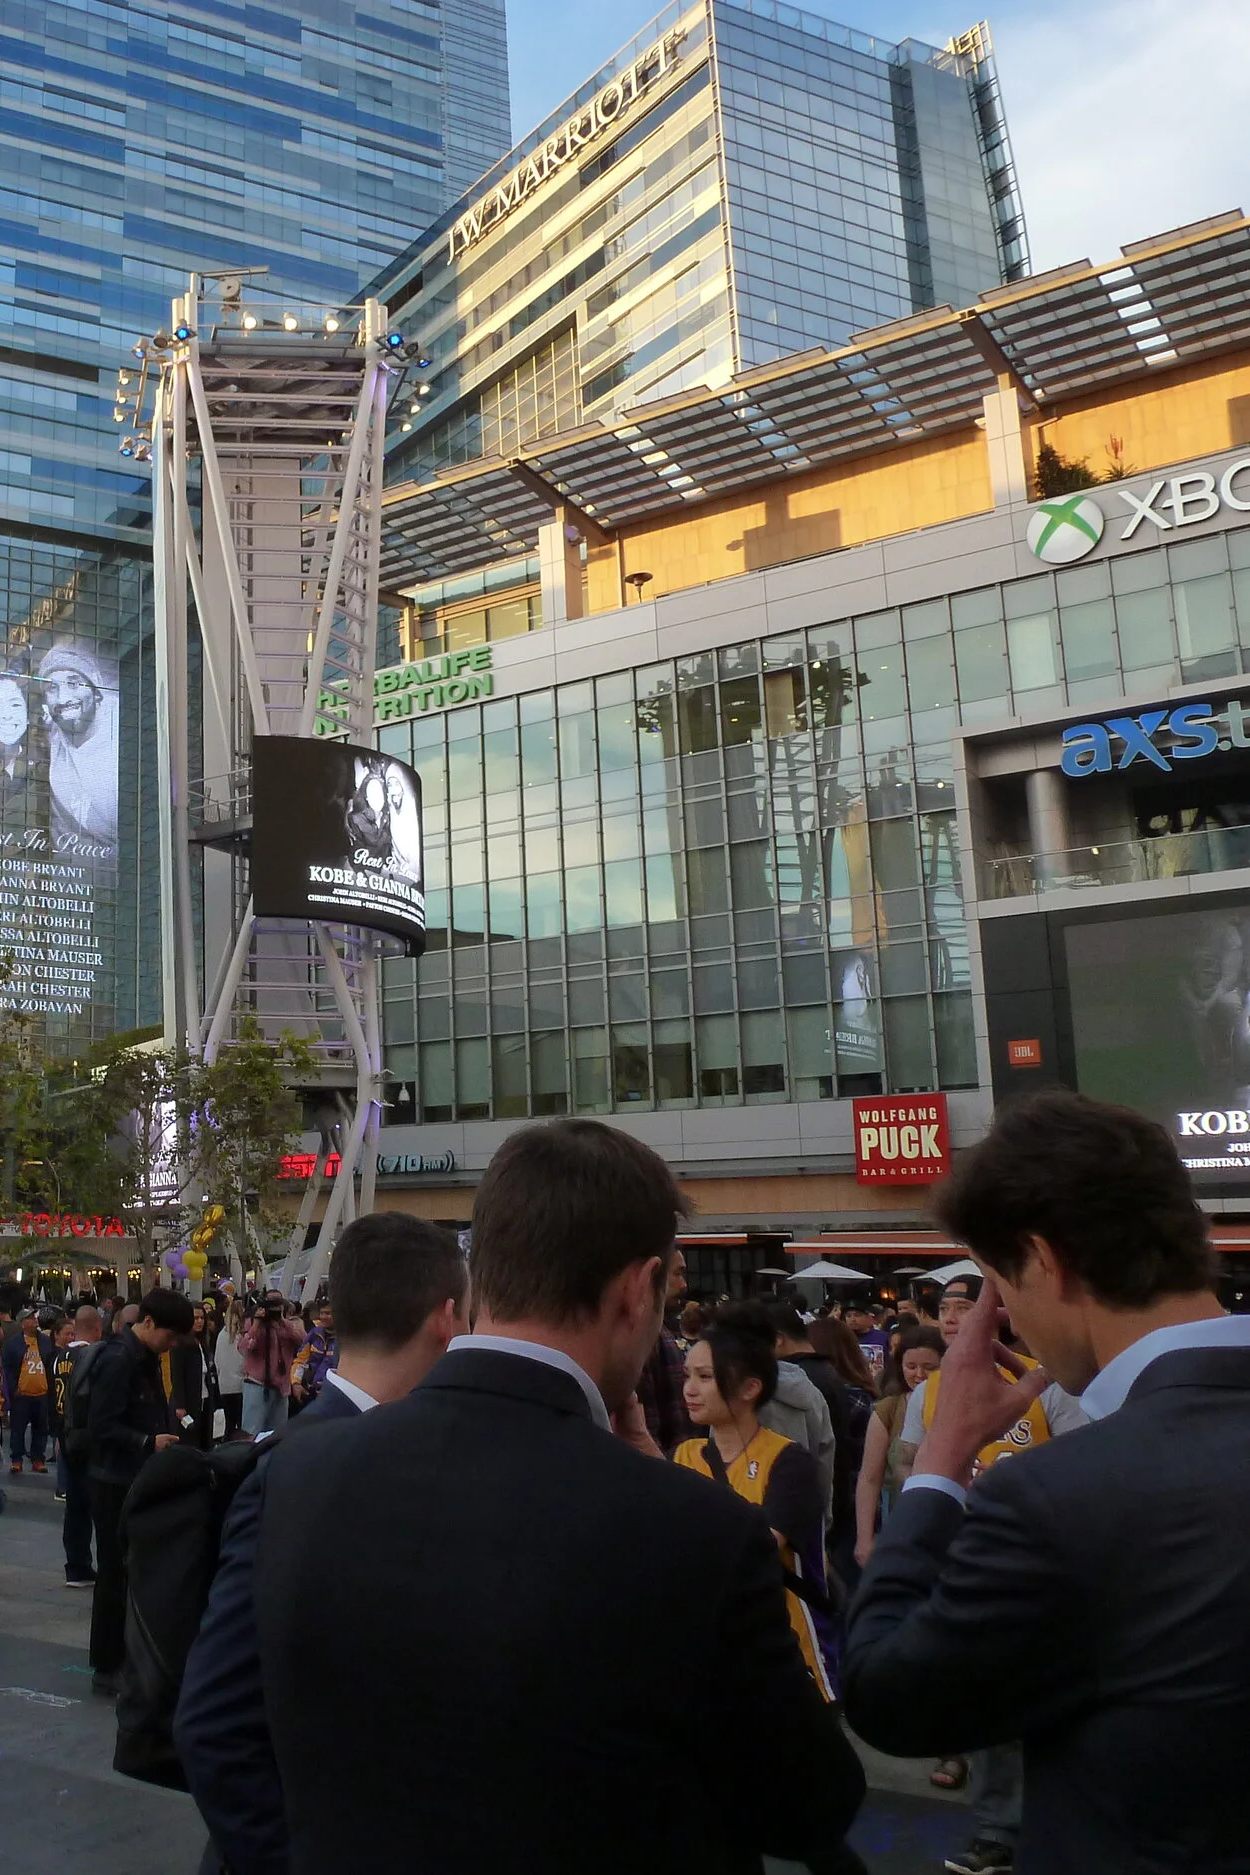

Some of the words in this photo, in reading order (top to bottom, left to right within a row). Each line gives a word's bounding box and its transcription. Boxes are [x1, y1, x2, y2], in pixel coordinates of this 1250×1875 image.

[447, 199, 488, 266] JW
[492, 28, 688, 218] MARRIOTT
[315, 673, 493, 736] NRITION
[17, 828, 49, 852] In
[52, 832, 113, 859] Peace
[353, 848, 383, 869] Rest
[33, 861, 86, 879] BRYANT
[41, 880, 93, 896] BRYANT
[309, 865, 355, 886] KOBE
[356, 871, 368, 888] &
[369, 875, 411, 901] GIANNA
[22, 895, 94, 913] ALTOBELLI
[20, 913, 91, 930] ALTOBELLI
[27, 930, 99, 948] ALTOBELLI
[48, 949, 104, 966] MAUSER
[34, 966, 96, 982] CHESTER
[31, 982, 91, 999] CHESTER
[20, 999, 82, 1014] ZOBAYAN
[1014, 1046, 1035, 1058] JBL
[859, 1107, 937, 1124] WOLFGANG
[860, 1124, 943, 1161] PUCK
[862, 1168, 886, 1176] BAR
[901, 1166, 943, 1175] GRILL
[18, 1211, 126, 1237] TOYOTA
[28, 1361, 45, 1375] 24
